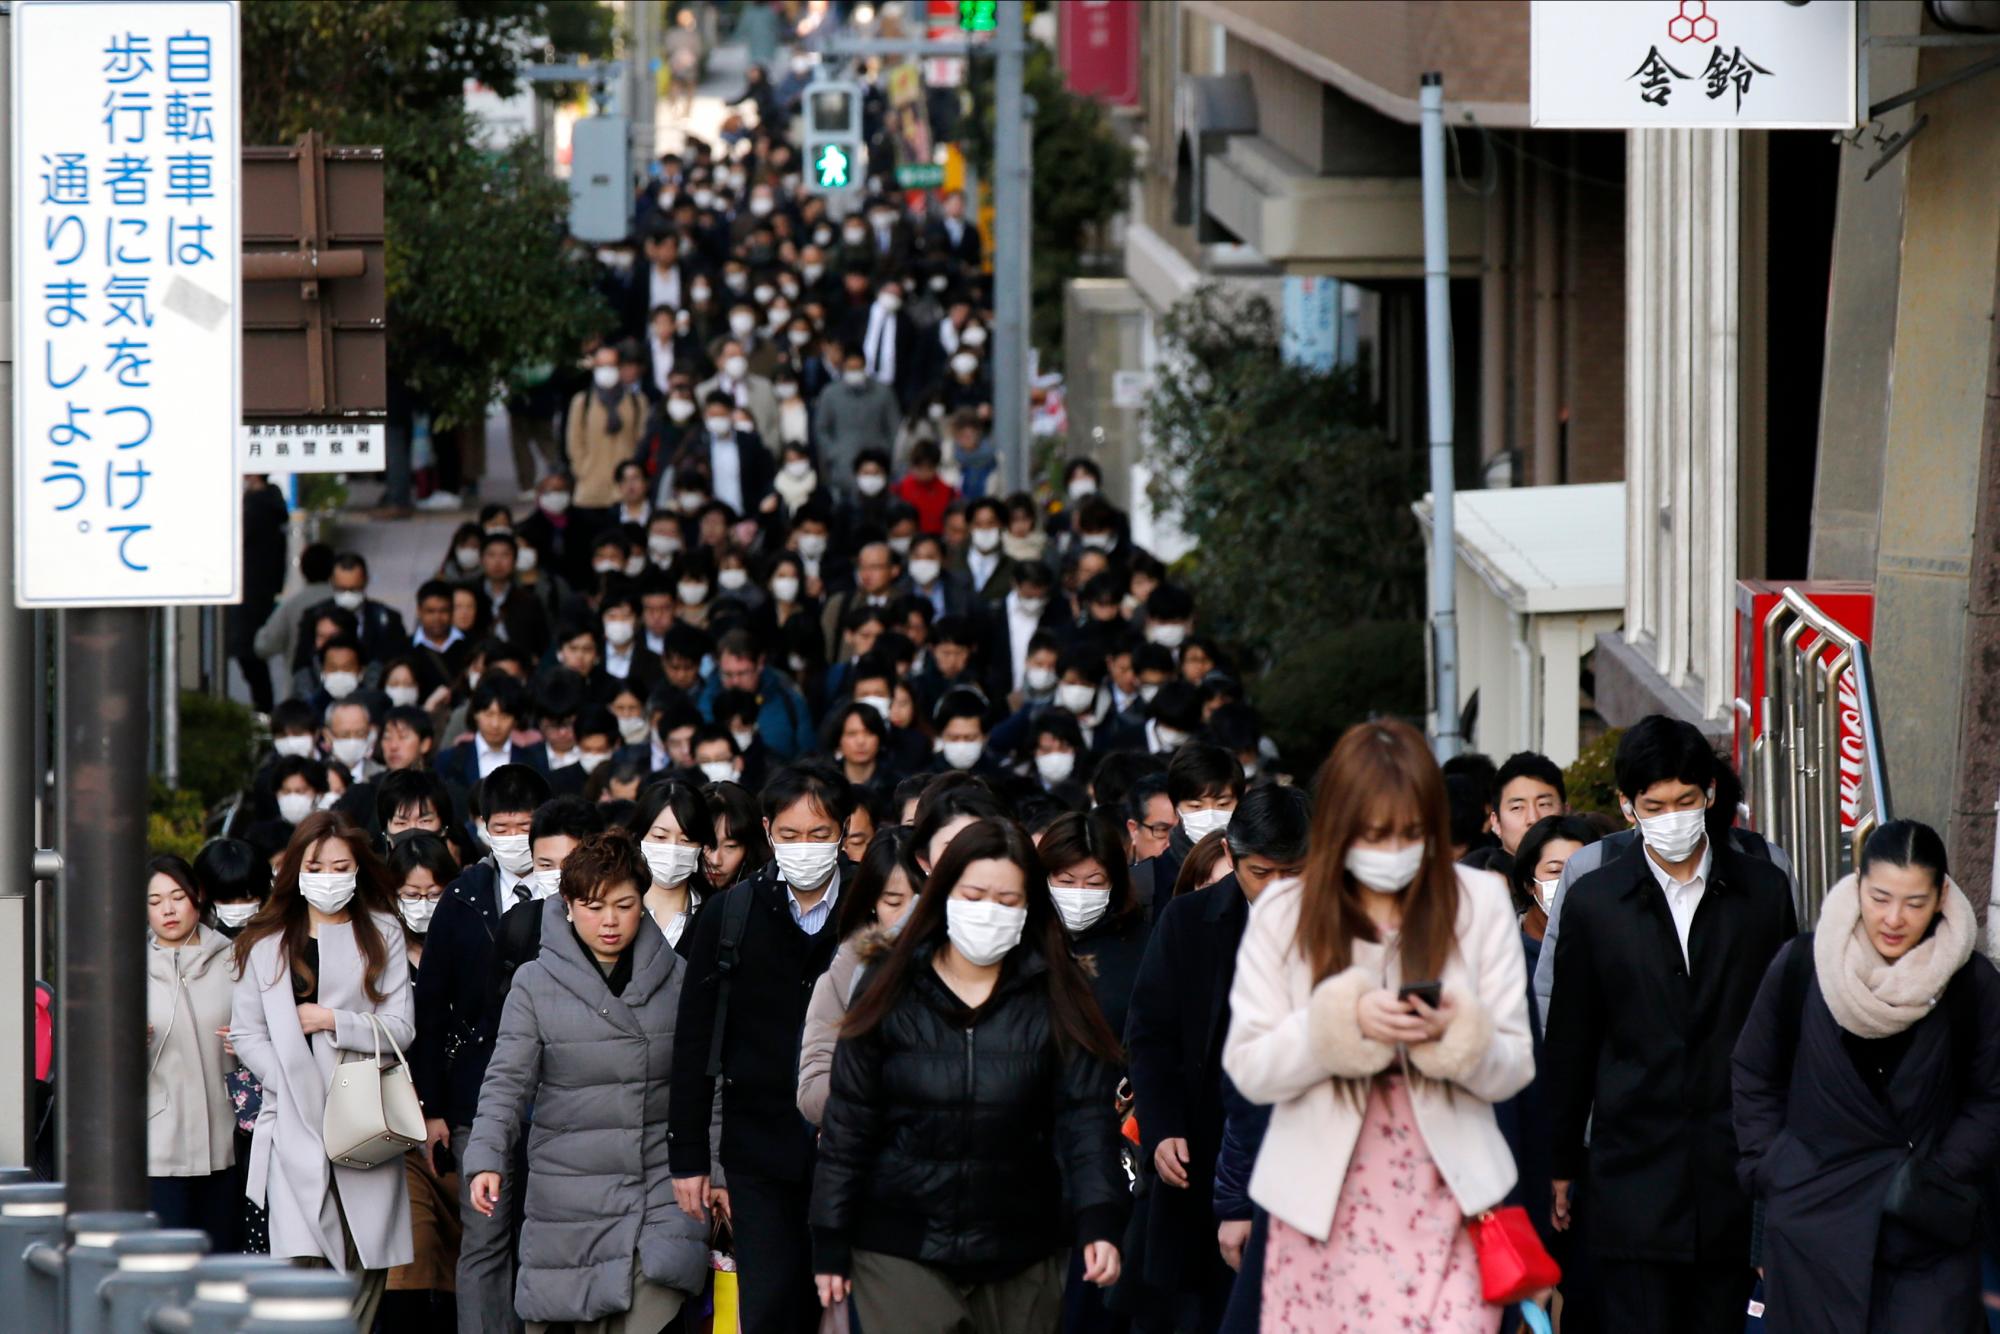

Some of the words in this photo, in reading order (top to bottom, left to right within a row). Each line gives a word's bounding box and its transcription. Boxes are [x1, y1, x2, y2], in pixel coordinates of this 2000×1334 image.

[164, 30, 215, 267] 自転車は
[1626, 44, 1775, 115] 舎鈴
[40, 152, 92, 534] 通りましょう。
[102, 32, 154, 573] 歩行者に気をつけて
